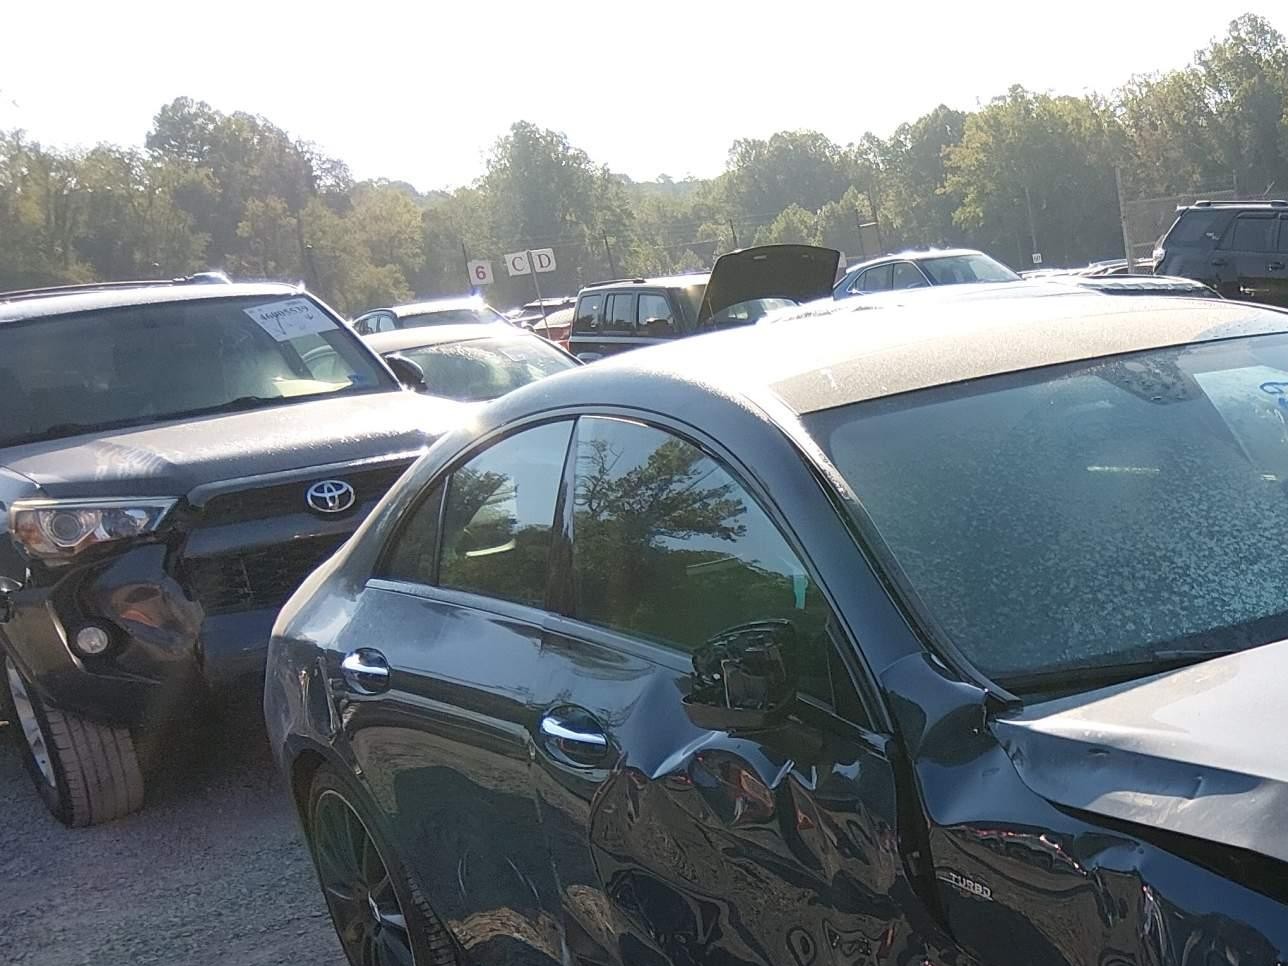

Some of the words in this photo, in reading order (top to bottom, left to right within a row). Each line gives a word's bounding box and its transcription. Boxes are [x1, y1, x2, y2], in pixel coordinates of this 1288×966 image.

[511, 256, 526, 273] C
[536, 252, 552, 269] D
[475, 265, 487, 281] 6
